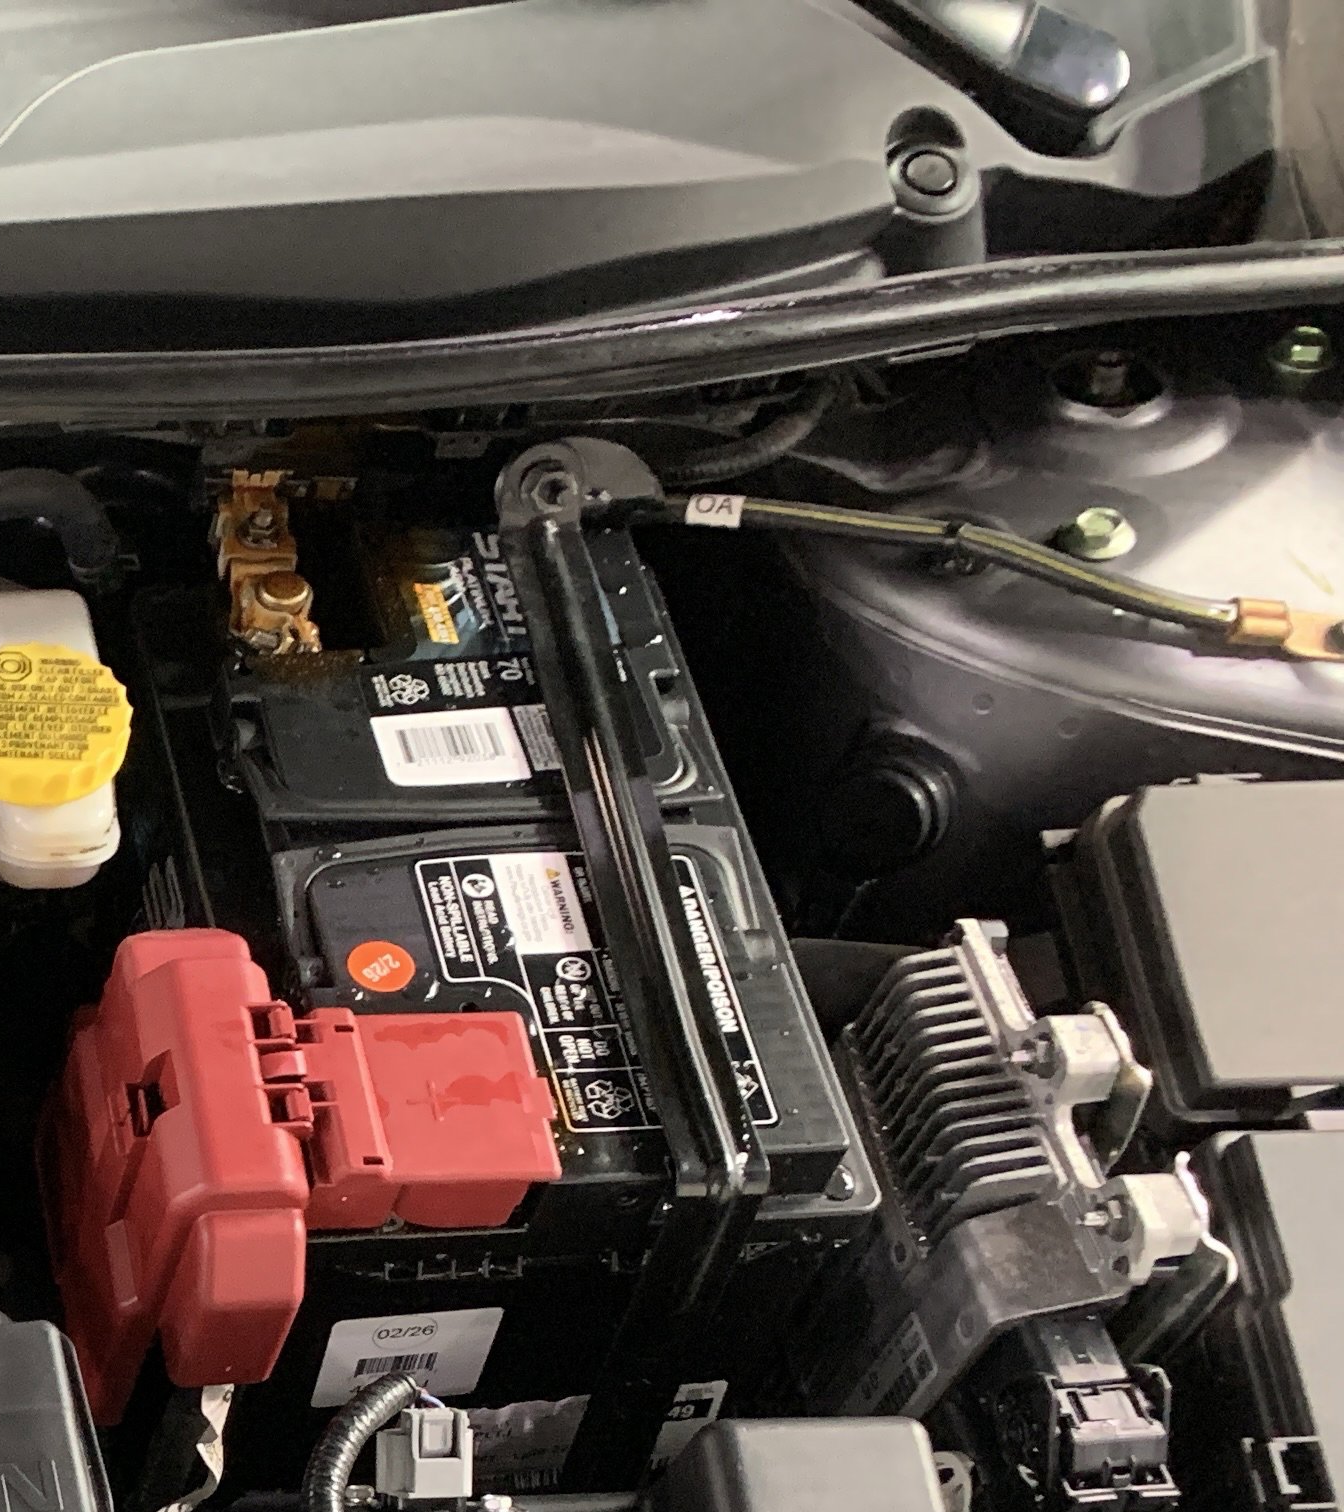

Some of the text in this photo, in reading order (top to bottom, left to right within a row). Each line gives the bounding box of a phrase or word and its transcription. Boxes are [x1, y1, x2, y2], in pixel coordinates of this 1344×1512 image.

[496, 657, 523, 681] 70
[438, 875, 474, 963] NON-SPILLABLE
[362, 953, 401, 982] 2/26
[576, 1038, 596, 1060] NOT
[593, 1040, 610, 1057] DO
[377, 1324, 435, 1340] 02/26
